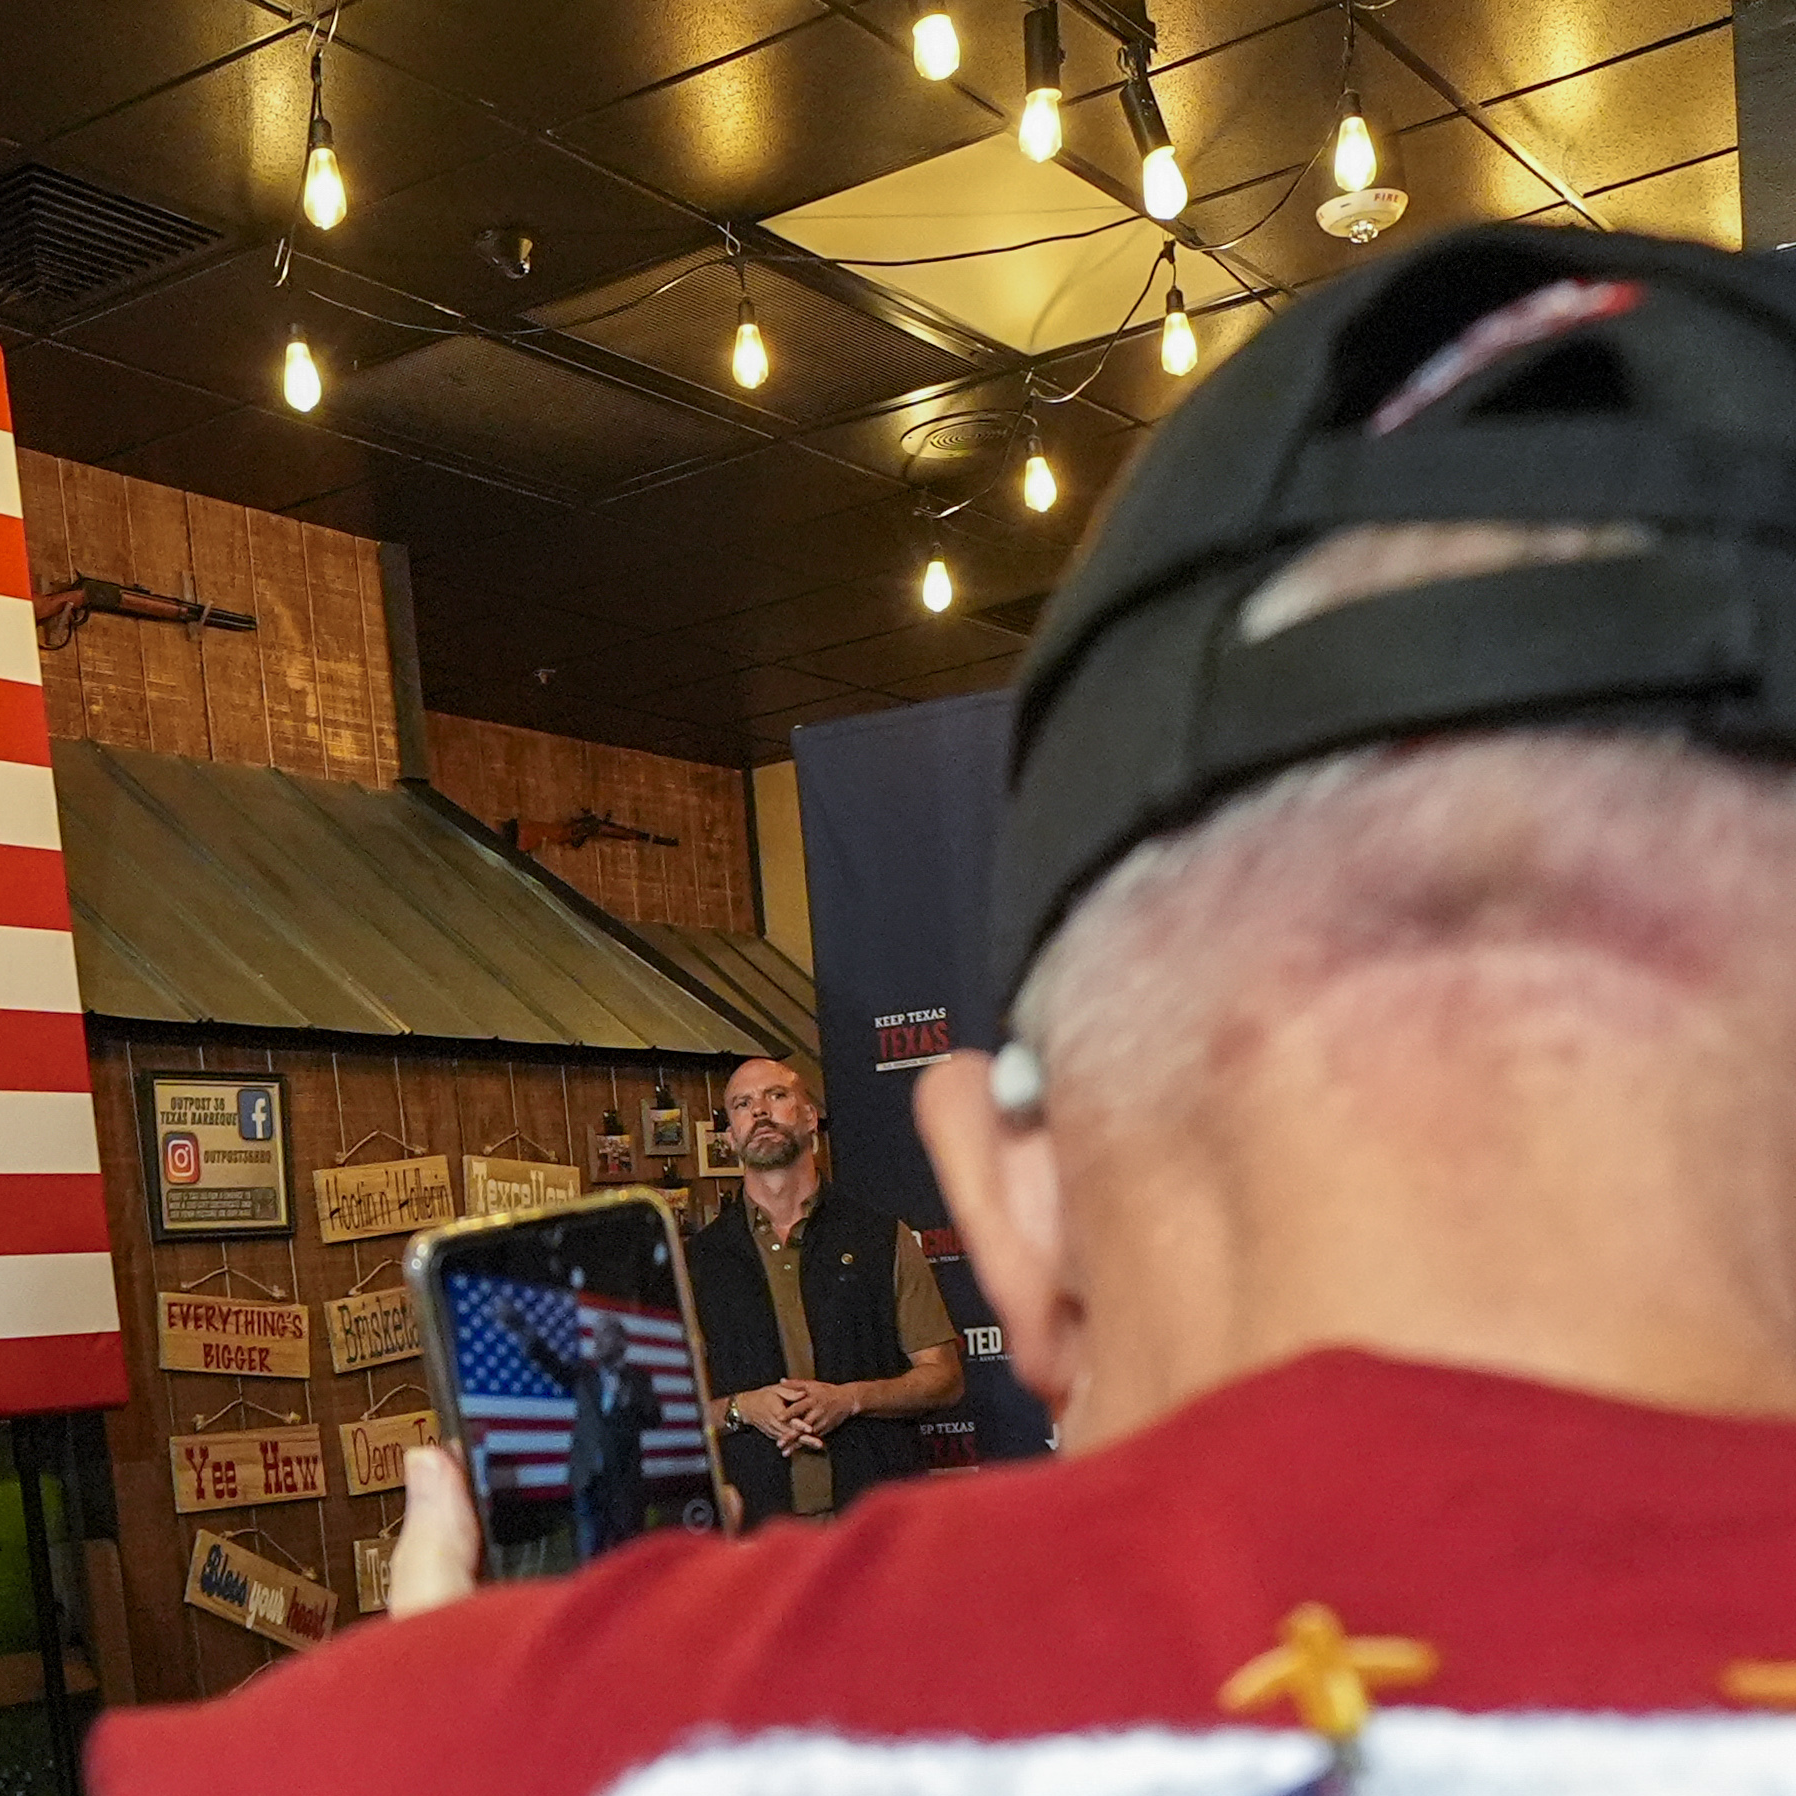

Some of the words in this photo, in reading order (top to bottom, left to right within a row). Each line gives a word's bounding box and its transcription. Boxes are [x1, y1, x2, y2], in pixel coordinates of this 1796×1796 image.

[874, 1014, 905, 1028] KEEP
[906, 1007, 947, 1023] TEXAS
[877, 1020, 951, 1059] TEXAS
[170, 1097, 212, 1110] OUTPOST
[160, 1112, 188, 1125] TEXAS
[190, 1113, 238, 1126] BARBEQUE
[167, 1302, 304, 1340] EVERYTHING'S
[963, 1326, 1002, 1356] TED
[203, 1343, 273, 1373] BIGGER
[936, 1421, 975, 1434] TEXAS
[184, 1446, 238, 1500] Yee
[259, 1440, 319, 1495] Haw
[200, 1543, 249, 1608] Bless
[245, 1580, 286, 1630] your
